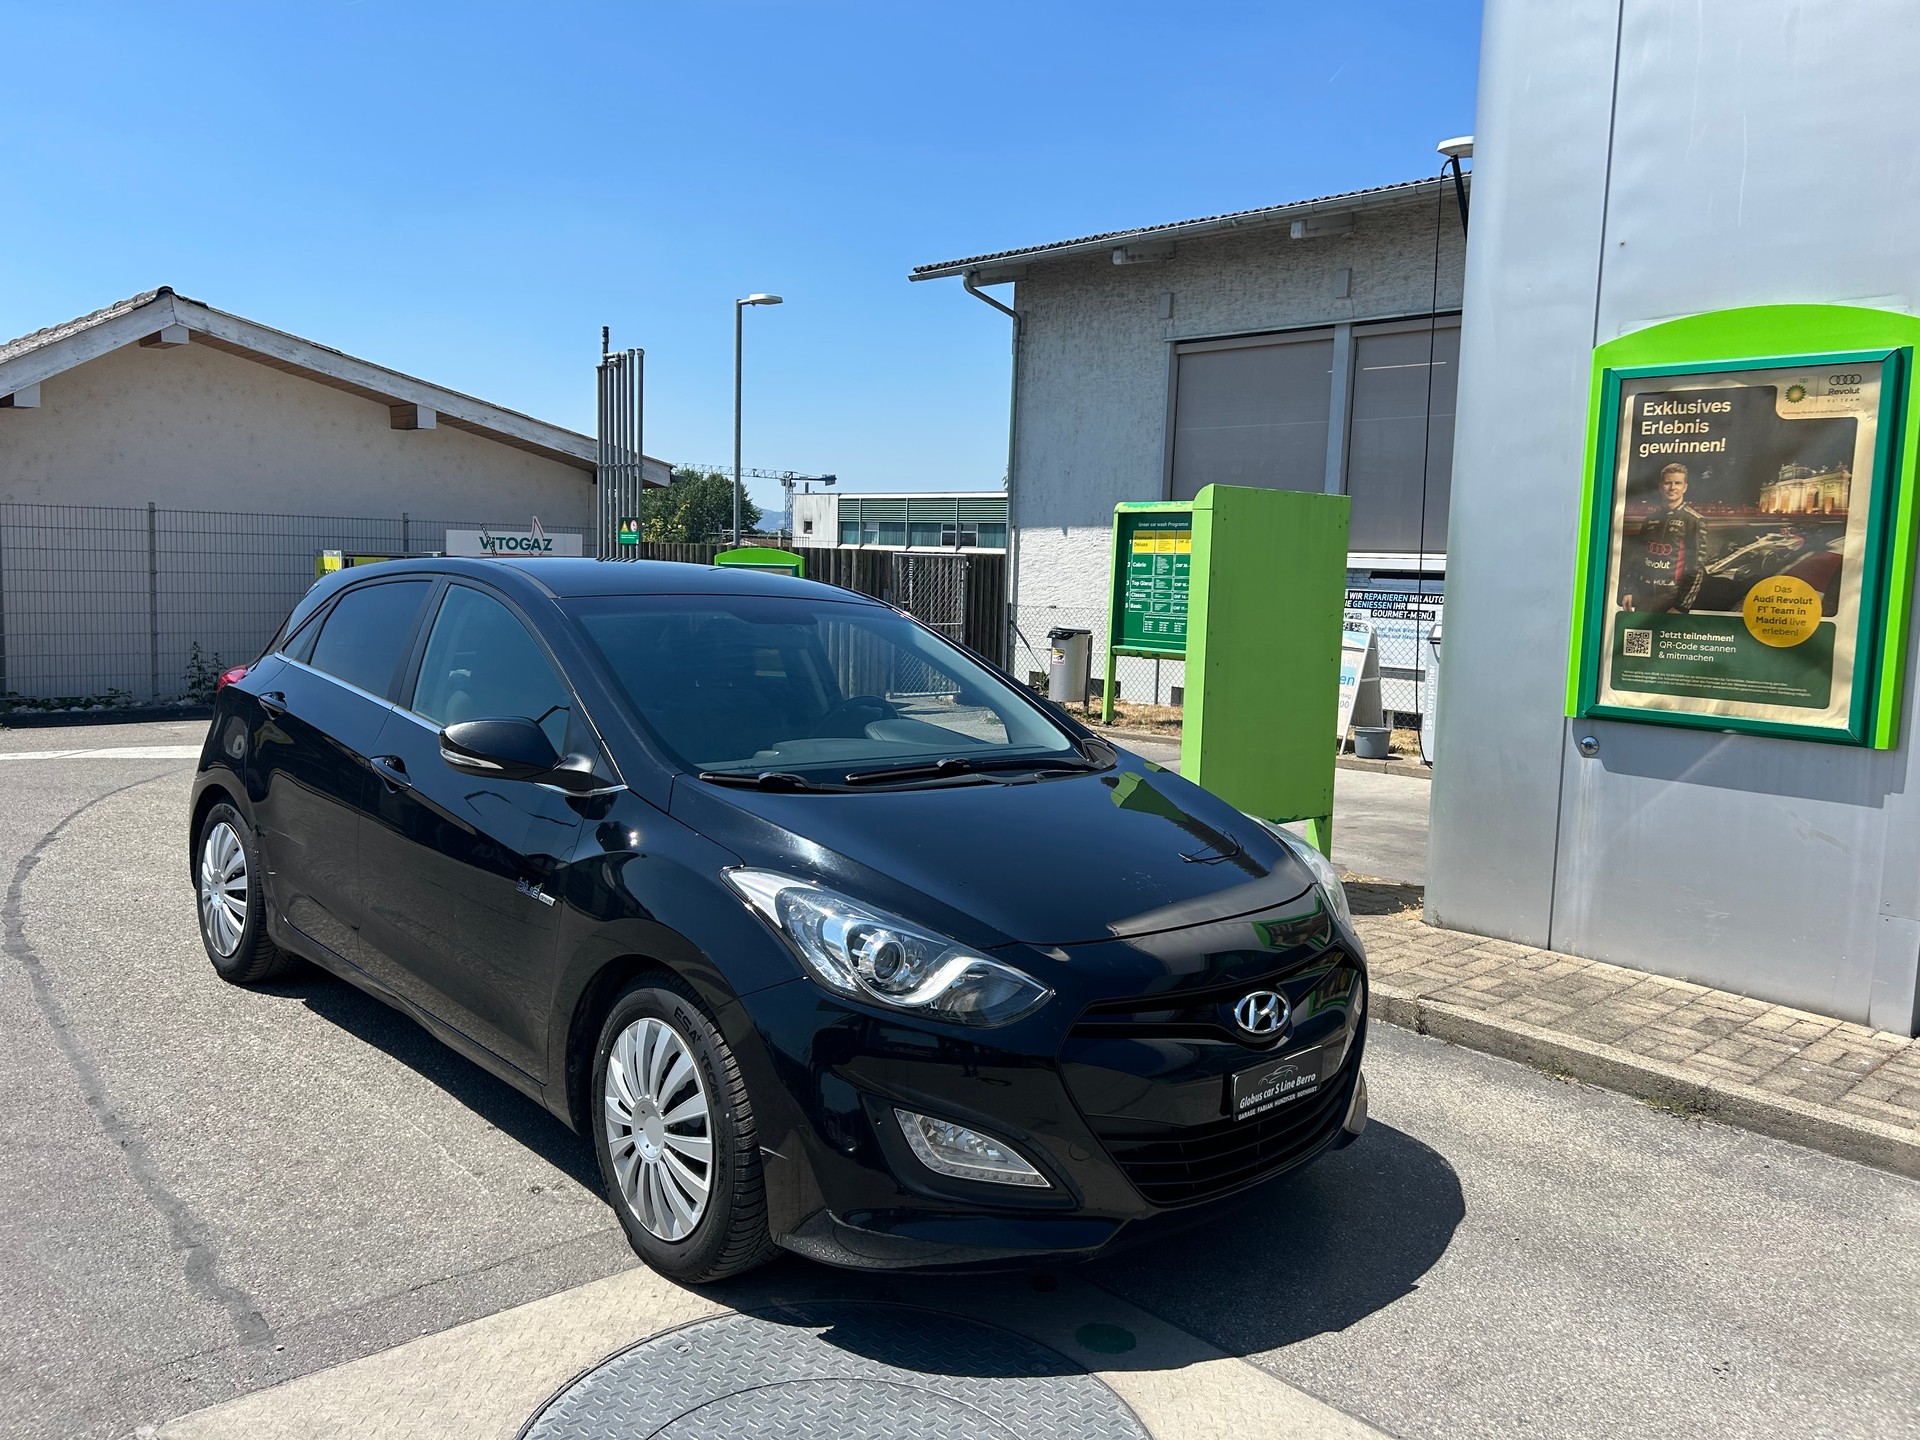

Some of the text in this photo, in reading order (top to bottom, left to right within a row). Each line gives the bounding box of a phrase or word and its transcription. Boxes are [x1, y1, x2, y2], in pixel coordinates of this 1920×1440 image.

[1829, 387, 1860, 395] Revolut
[1643, 399, 1732, 417] Exklusives
[1641, 421, 1710, 435] Erlebnis
[1639, 438, 1726, 458] gewinnen!
[1774, 585, 1792, 594] Das
[1349, 592, 1363, 600] WIR
[1363, 593, 1408, 602] REPARIEREN
[1409, 595, 1422, 603] IHR
[1753, 595, 1813, 605] Audi Revolut
[1353, 601, 1392, 609] GENIESSEN
[1393, 602, 1406, 610] IHR
[1771, 606, 1794, 615] Team
[1796, 607, 1806, 615] in
[1756, 616, 1807, 626] Madrid live
[1659, 630, 1735, 642] Jetzt teilnehmen!
[1762, 628, 1799, 636] erleben!
[1659, 640, 1737, 653] QR-Code scannen
[1658, 650, 1714, 662] & mitmachen
[1425, 664, 1436, 731] SB-Vorsprüher
[516, 877, 541, 900] blue
[1240, 1073, 1316, 1109] Globus car S Line Berro
[1238, 1109, 1256, 1121] GARAGE
[1257, 1101, 1274, 1113] FABIAN
